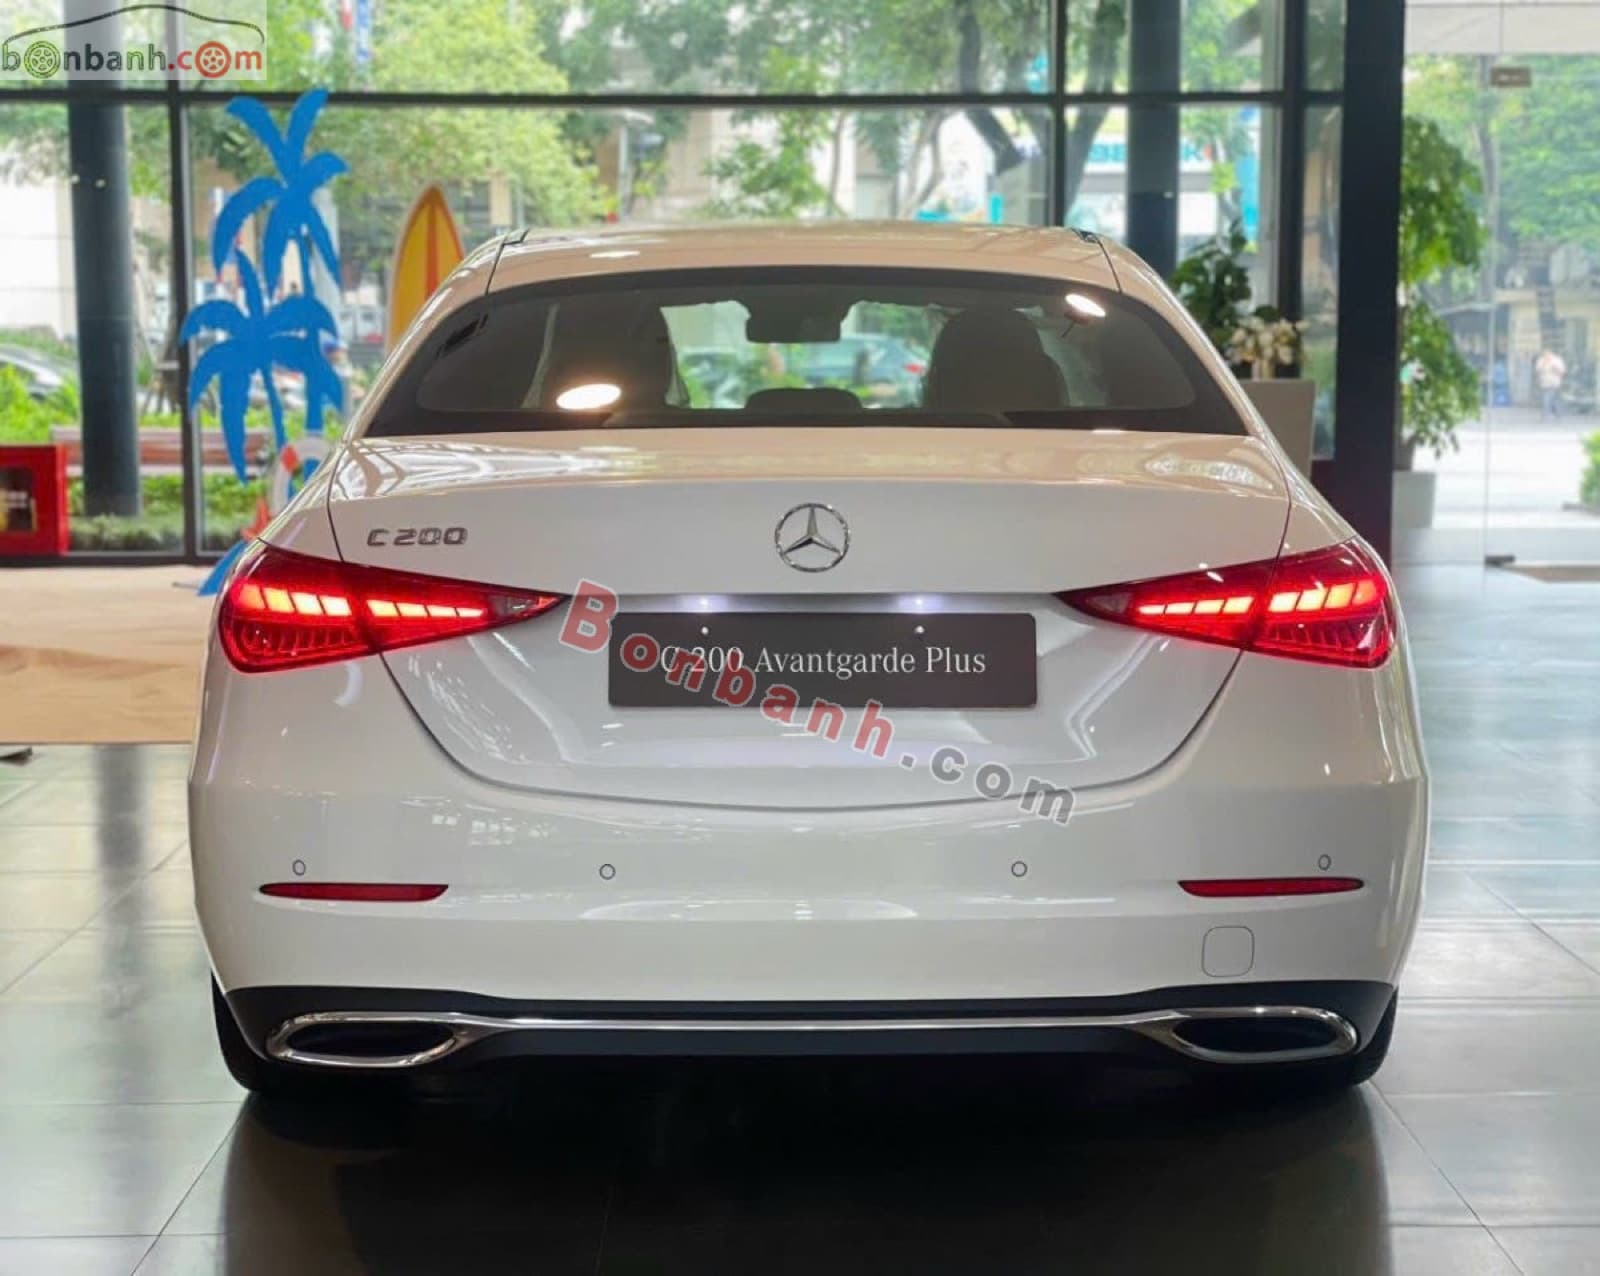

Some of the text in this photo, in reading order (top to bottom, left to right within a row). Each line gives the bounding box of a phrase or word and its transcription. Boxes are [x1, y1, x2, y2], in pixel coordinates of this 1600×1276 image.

[367, 527, 468, 546] C 200
[690, 646, 743, 673] 200
[754, 646, 916, 680] Avantgarde
[925, 646, 986, 673] Plus
